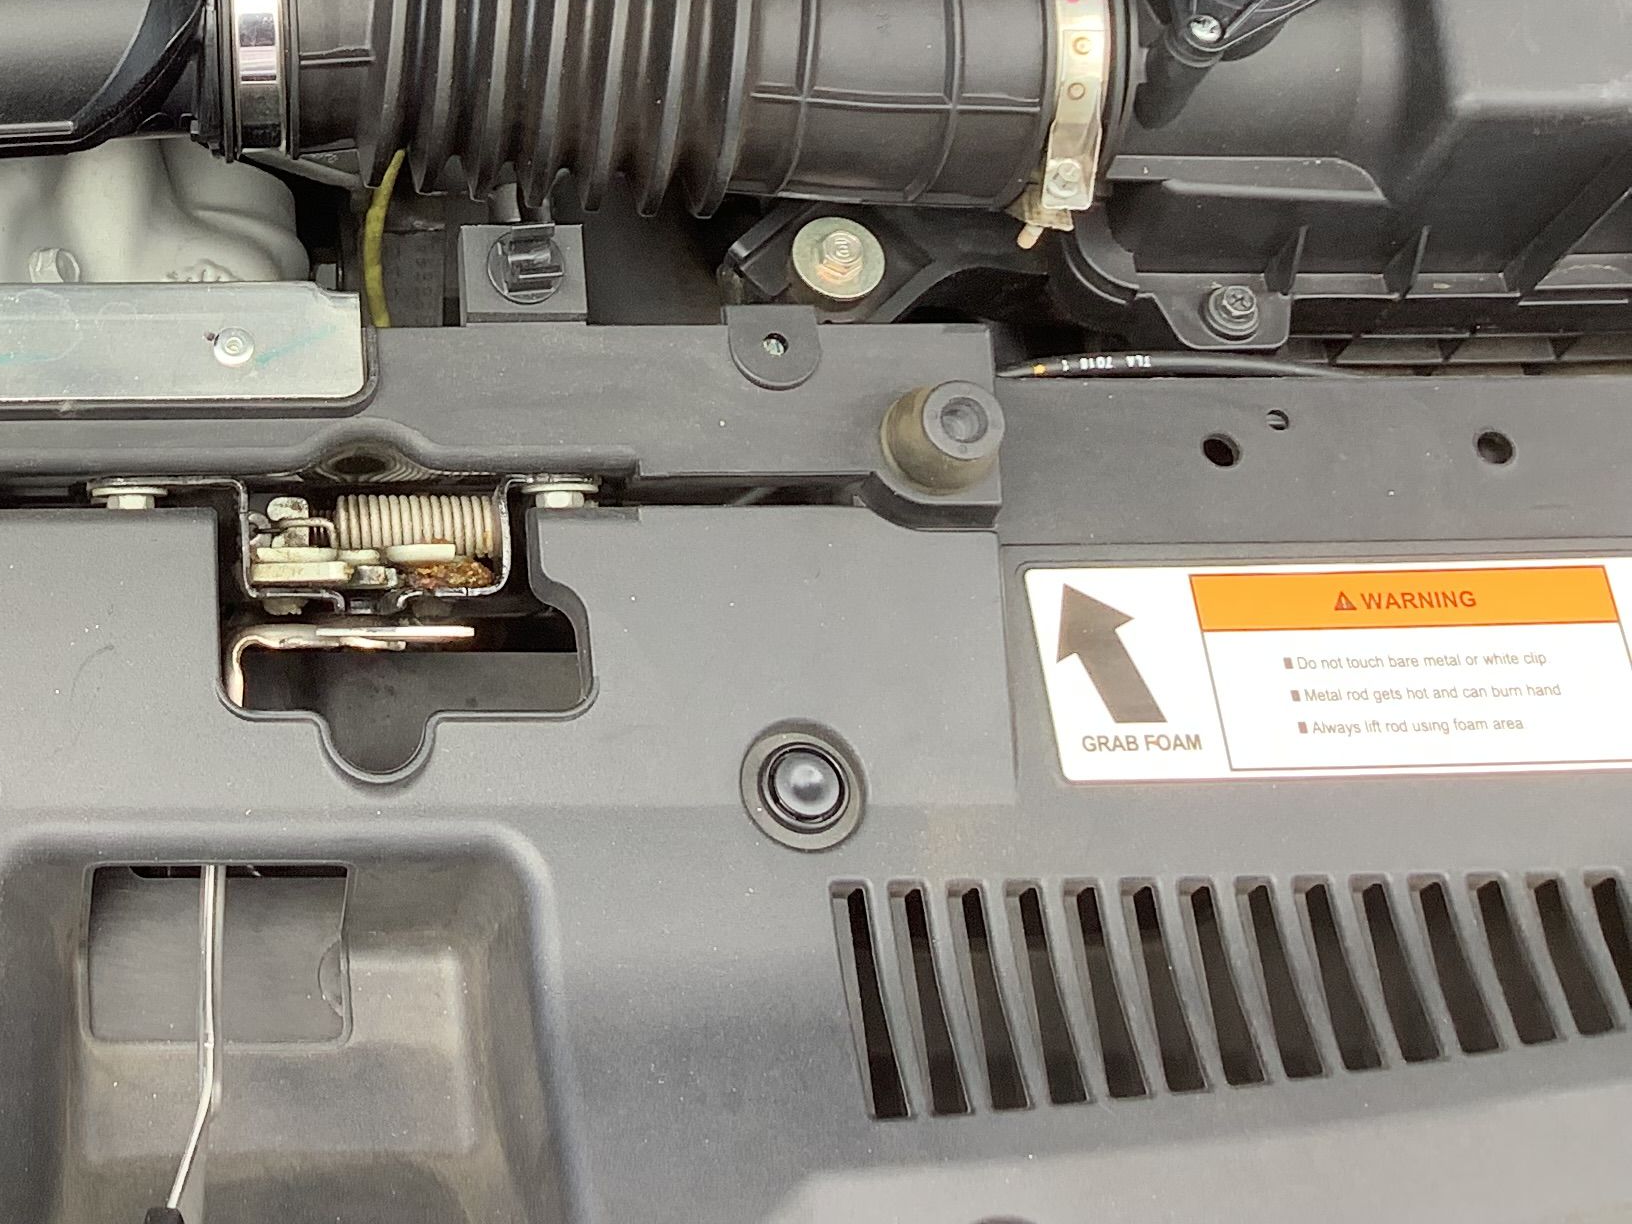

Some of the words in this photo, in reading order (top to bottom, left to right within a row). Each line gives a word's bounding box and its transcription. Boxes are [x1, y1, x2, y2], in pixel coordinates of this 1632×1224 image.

[1361, 590, 1477, 610] WARNING
[1298, 657, 1317, 670] Do
[1321, 657, 1343, 669] not
[1347, 656, 1384, 668] touch
[1389, 655, 1419, 668] bare
[1424, 654, 1461, 667] metal
[1466, 655, 1478, 666] or
[1483, 653, 1519, 665] white
[1304, 688, 1343, 702] Metal
[1347, 688, 1369, 701] rod
[1374, 688, 1402, 704] gets
[1407, 687, 1429, 699] hot
[1434, 686, 1458, 699] and
[1463, 687, 1487, 698] can
[1492, 685, 1522, 697] burn
[1527, 684, 1561, 697] hand
[1312, 720, 1362, 737] Always
[1365, 719, 1382, 733] lift
[1385, 720, 1409, 732] rod
[1413, 720, 1450, 735] using
[1453, 718, 1488, 731] foam
[1493, 718, 1525, 730] area
[1082, 735, 1139, 753] GRAB
[1145, 734, 1202, 752] FOAM
